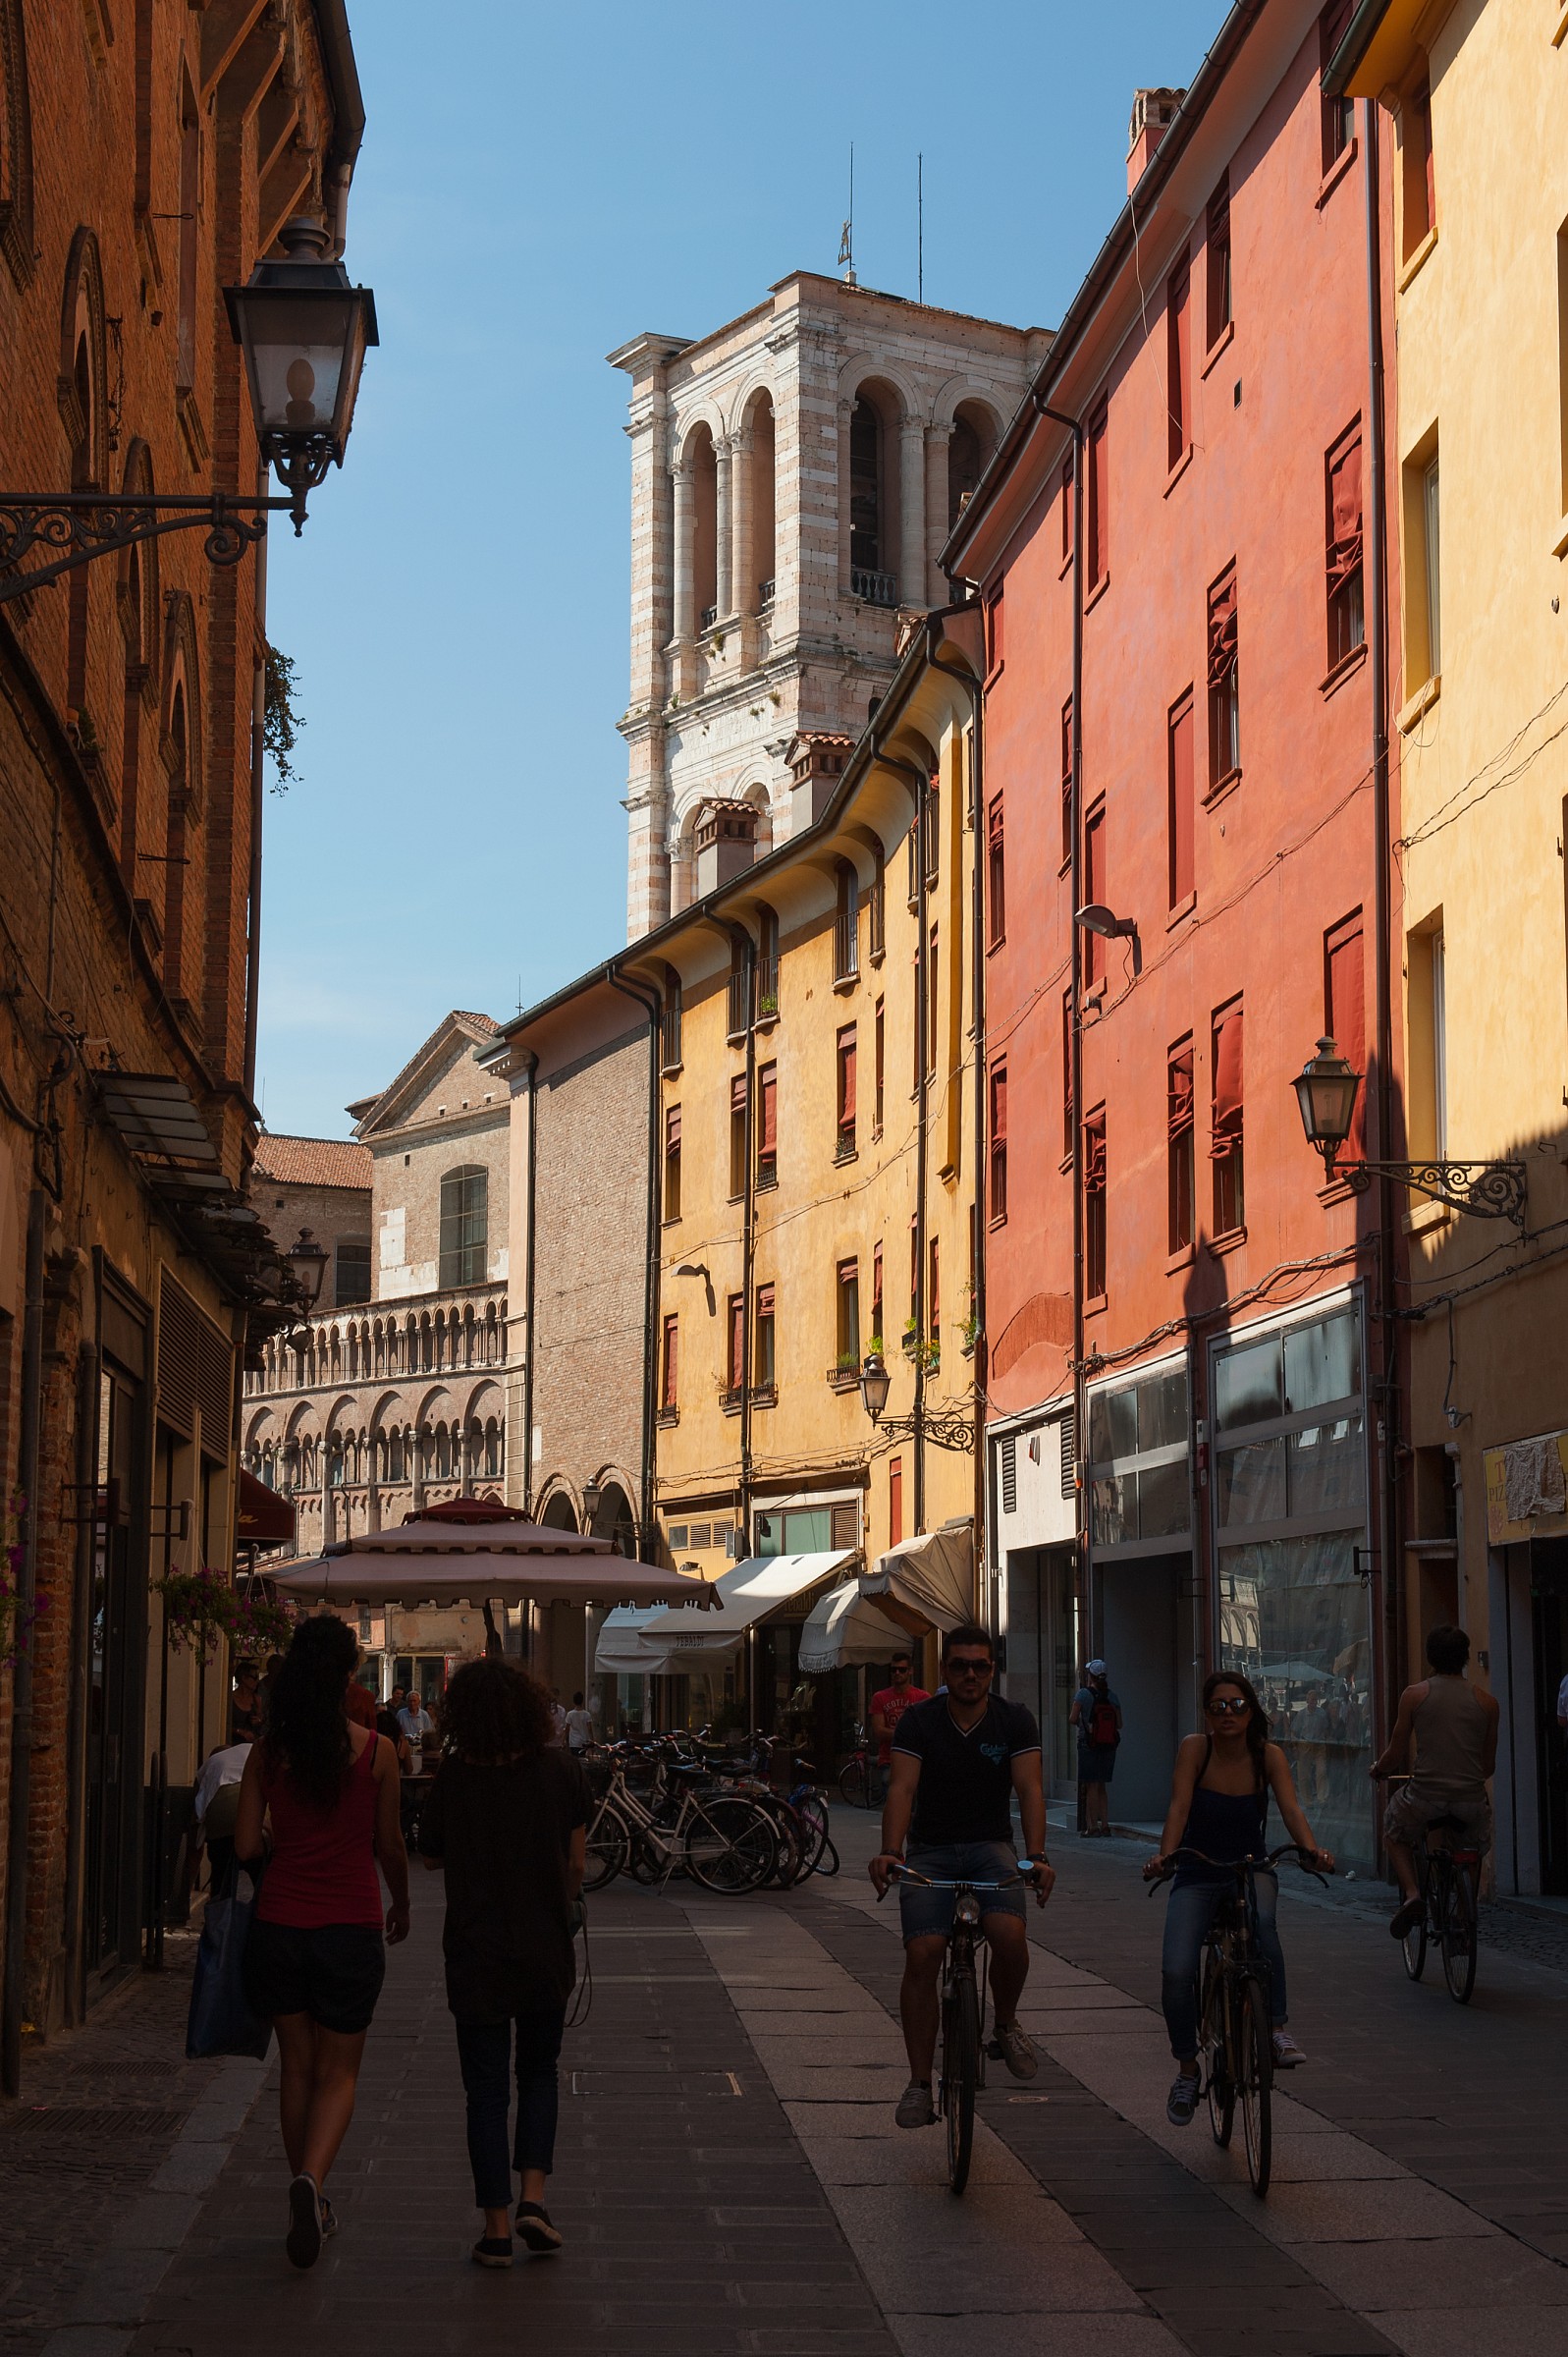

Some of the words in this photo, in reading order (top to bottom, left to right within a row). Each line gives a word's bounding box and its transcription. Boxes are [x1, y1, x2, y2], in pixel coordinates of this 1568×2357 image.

[1487, 1484, 1505, 1502] PIZ
[676, 1635, 705, 1648] TEBALDI
[883, 1698, 913, 1712] SCOTLA
